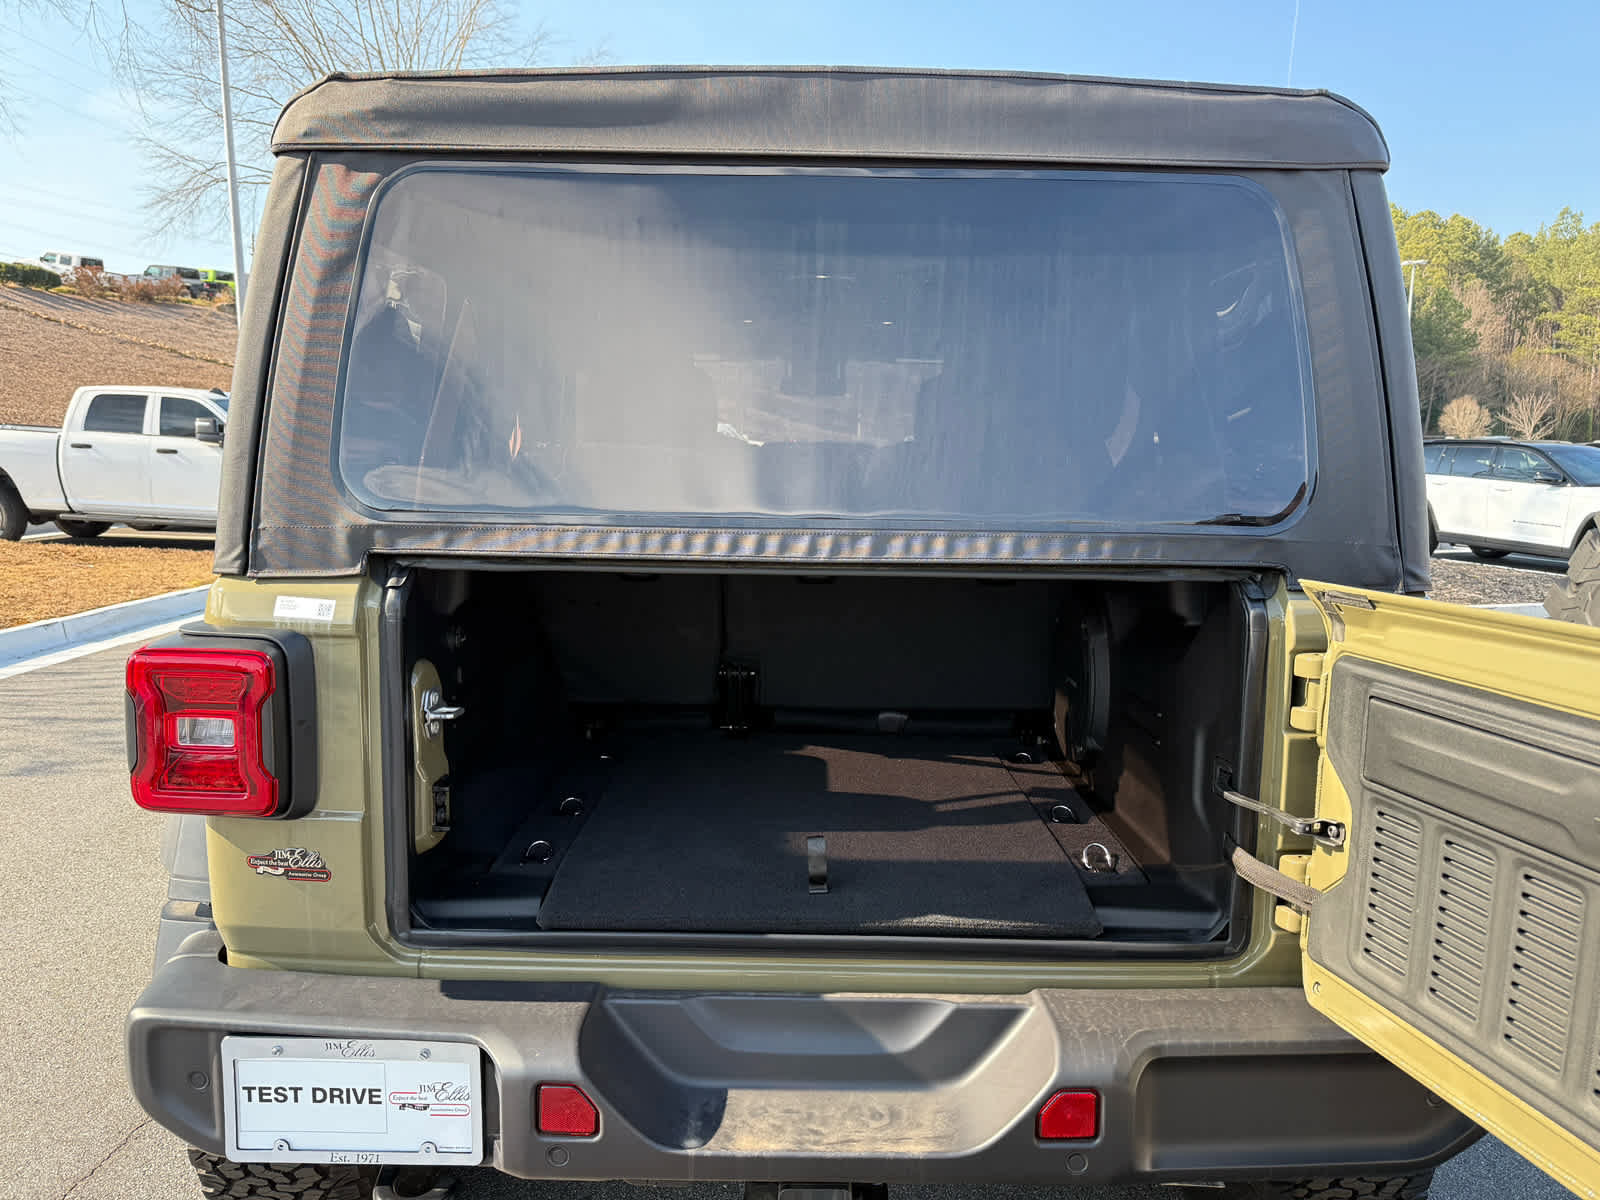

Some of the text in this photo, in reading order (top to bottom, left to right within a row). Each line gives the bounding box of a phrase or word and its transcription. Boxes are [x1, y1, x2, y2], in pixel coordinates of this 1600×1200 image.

[274, 848, 322, 868] JIM Ellis
[324, 1040, 377, 1058] JIM Ellis
[242, 1086, 383, 1105] TEST DRIVE
[418, 1081, 471, 1102] JIM Ellis
[330, 1152, 382, 1164] Est. 1971
